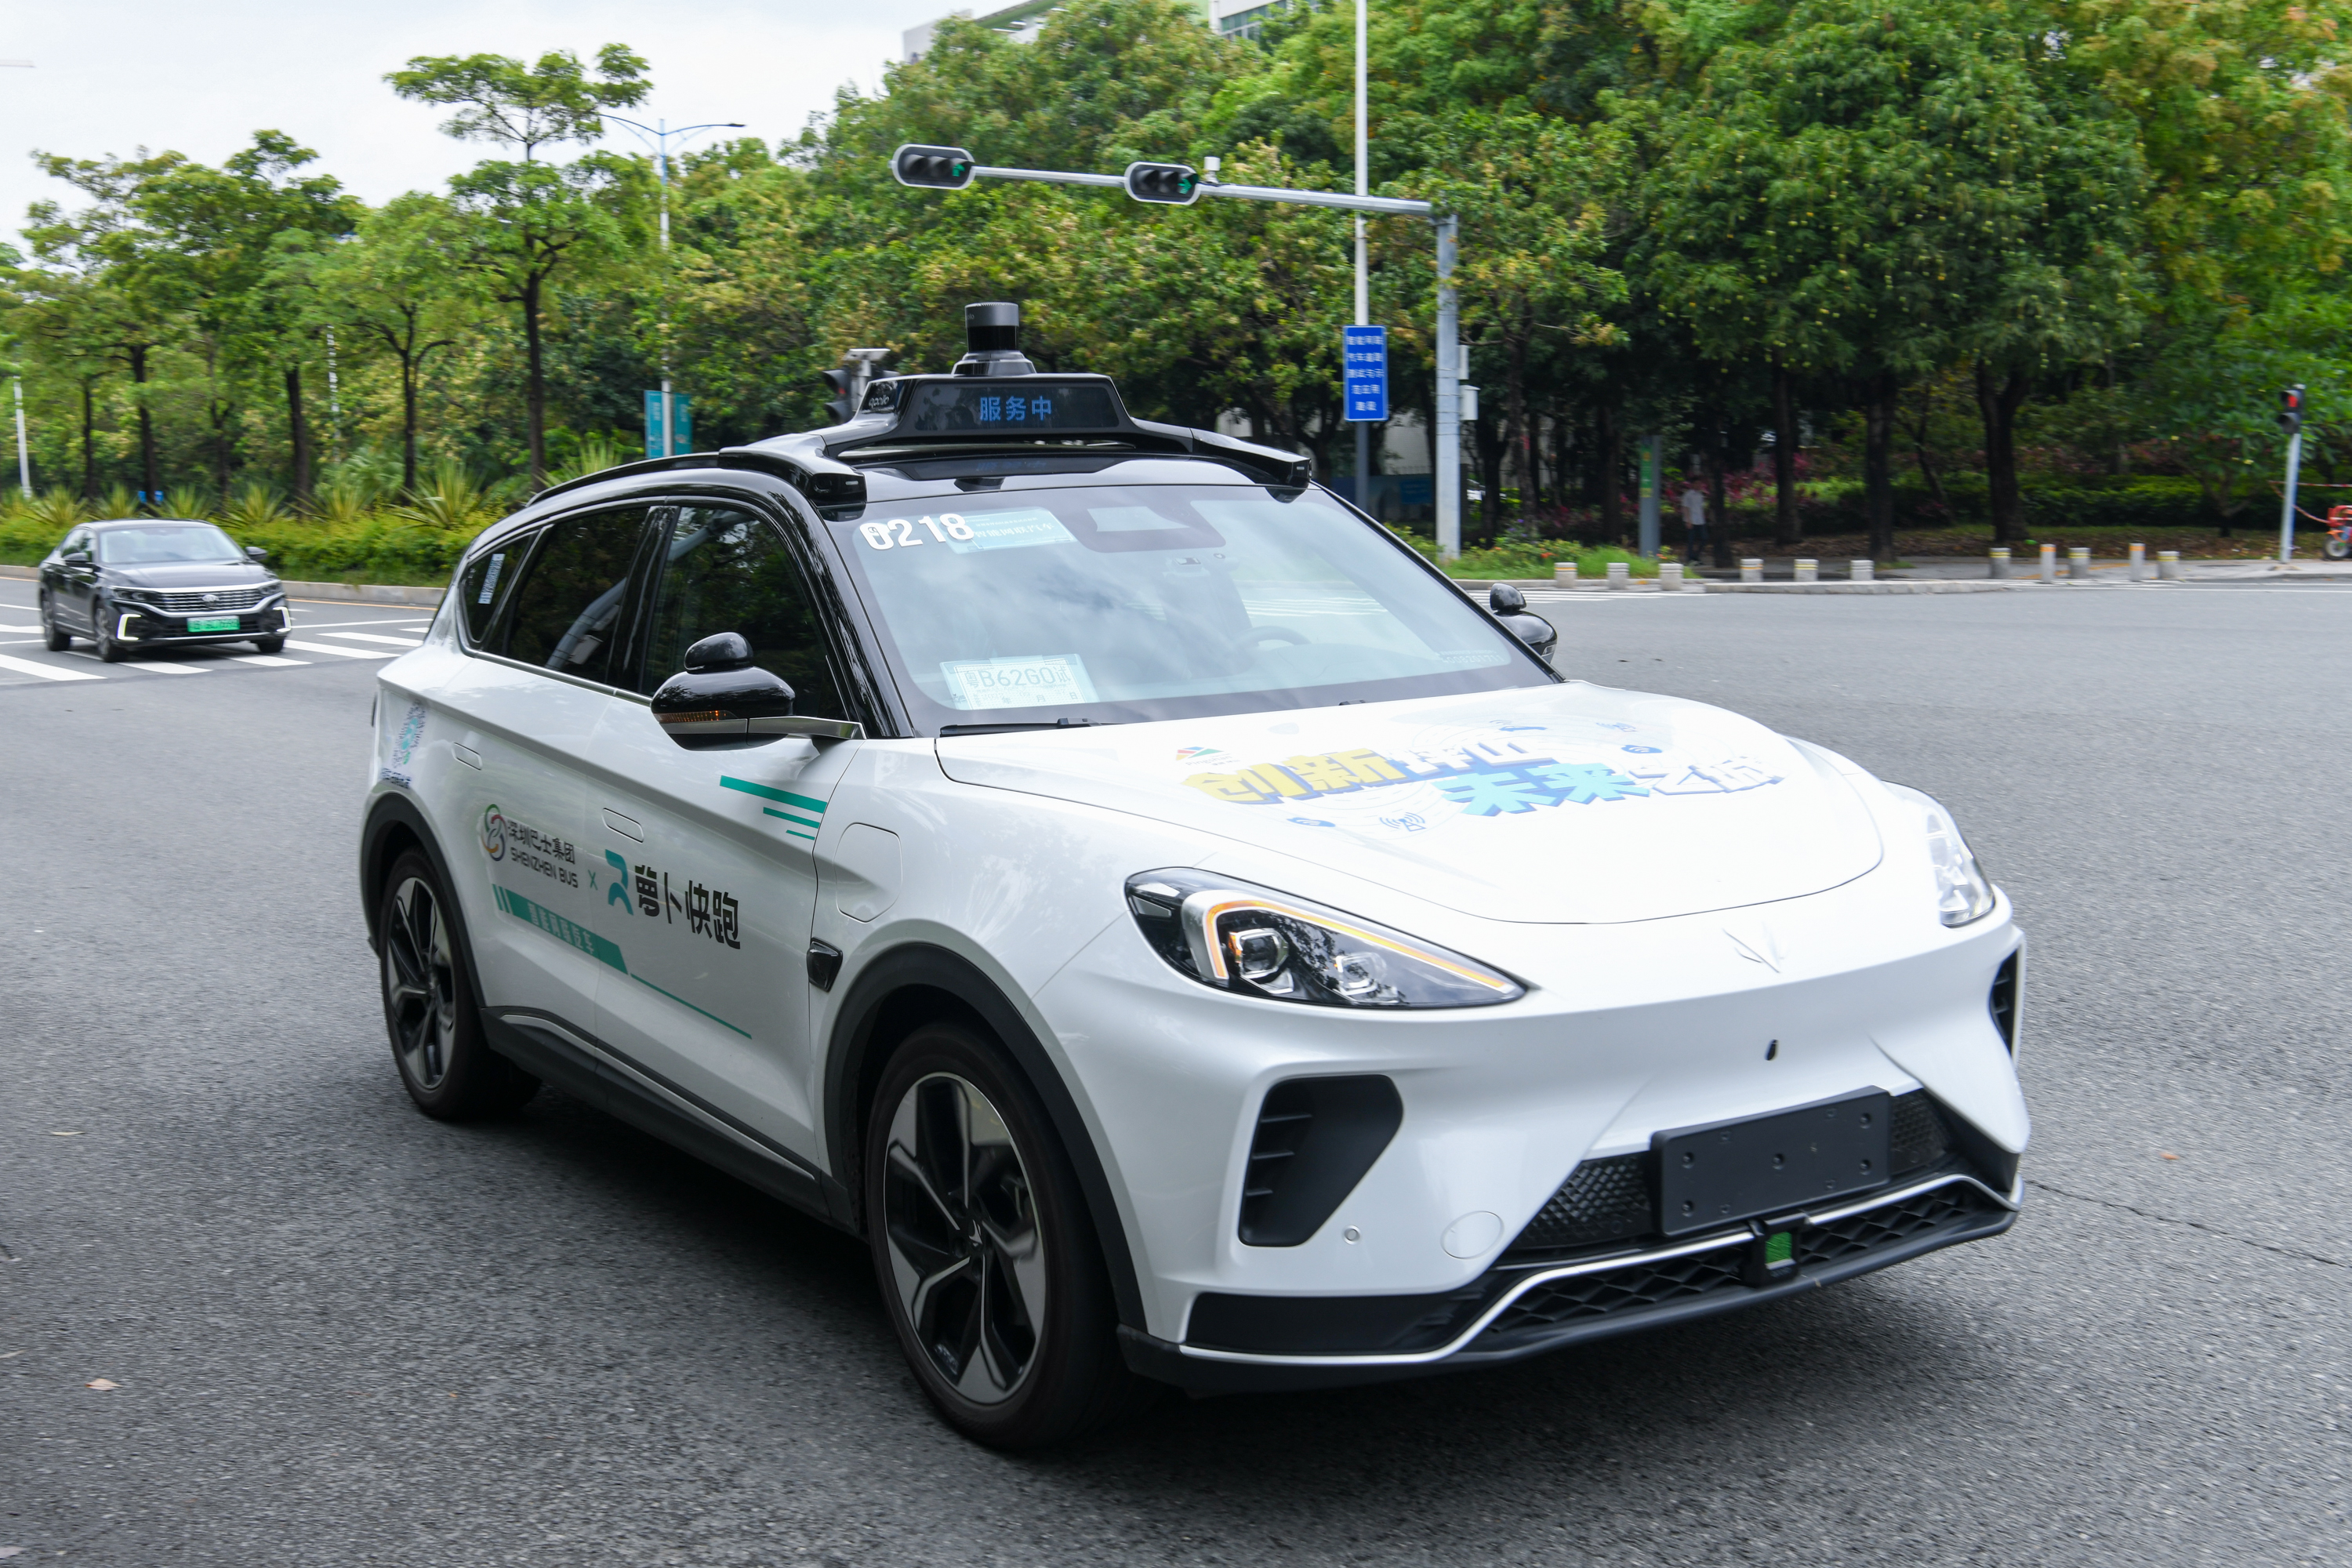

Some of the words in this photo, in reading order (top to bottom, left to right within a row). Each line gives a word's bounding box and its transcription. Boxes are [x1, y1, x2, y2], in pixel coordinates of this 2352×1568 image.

[980, 395, 1051, 421] 服务中
[860, 514, 975, 550] 0218
[1181, 741, 1553, 804] 创新坪山
[1185, 756, 1233, 766] Pingshan
[1432, 757, 1785, 816] 未来之城
[508, 819, 575, 865] 深圳巴士集团
[510, 847, 557, 879] SHENZHEN
[559, 867, 579, 888] BUS
[634, 865, 741, 950] 萝卜快跑
